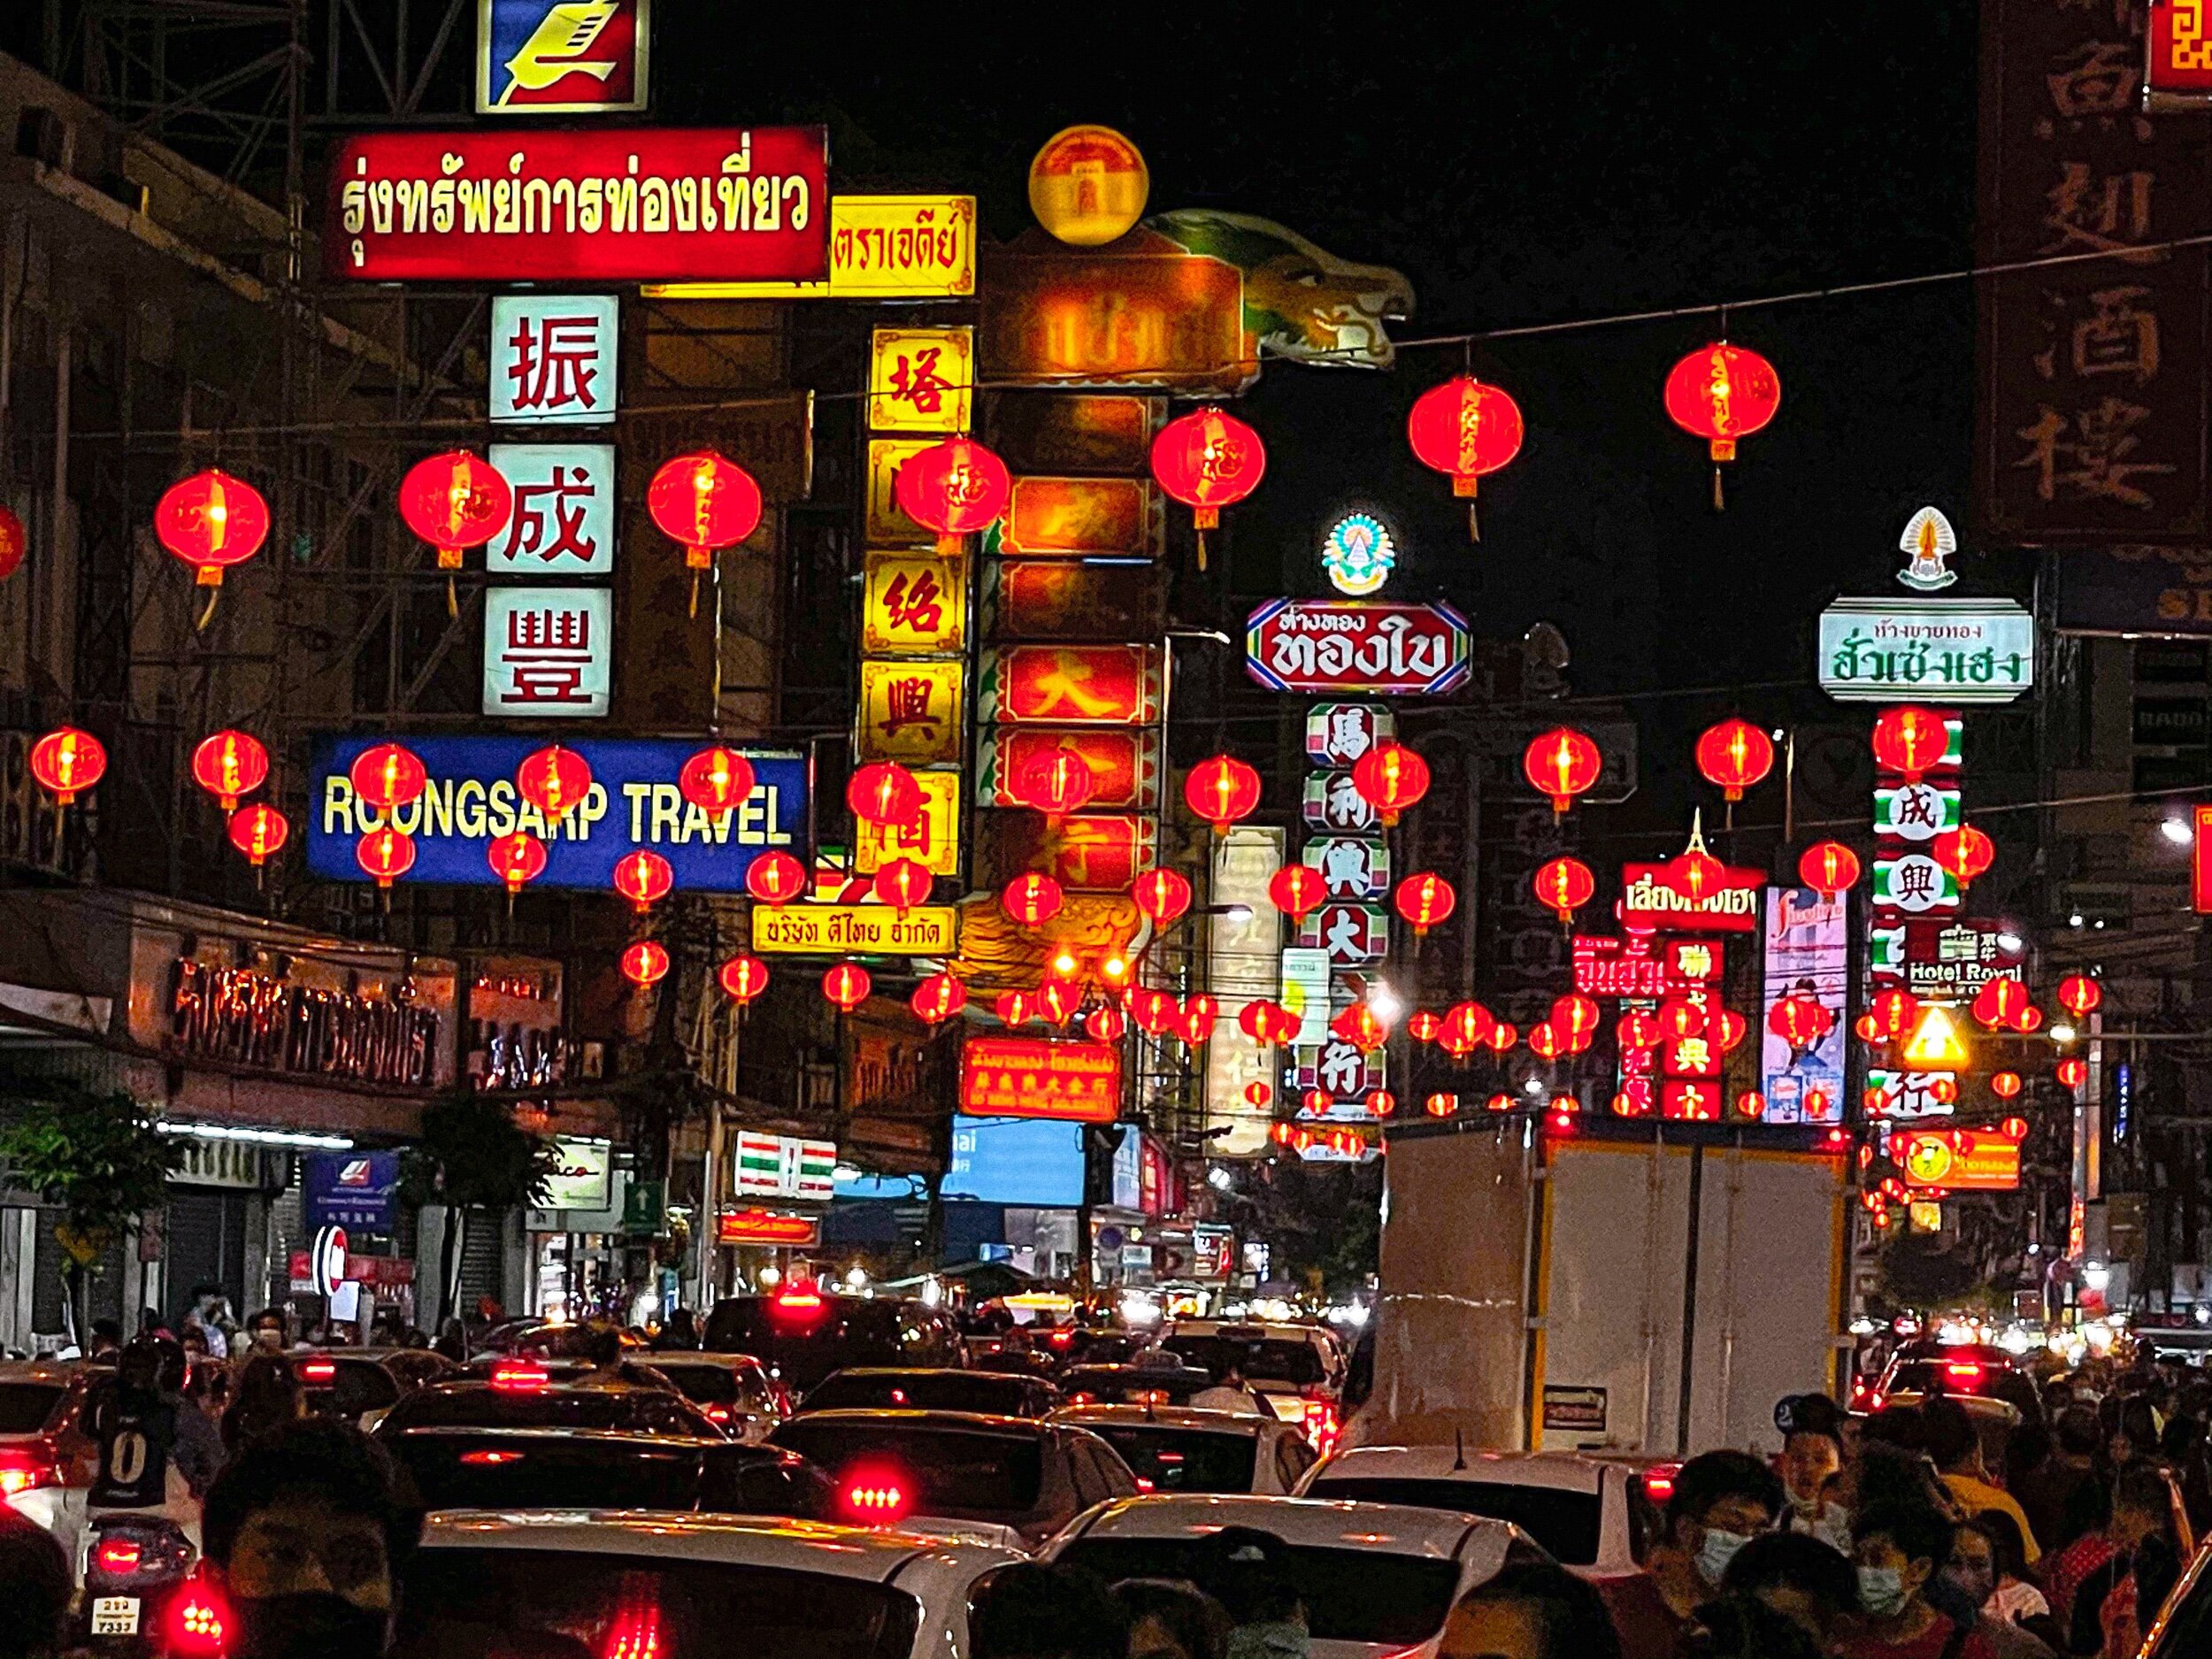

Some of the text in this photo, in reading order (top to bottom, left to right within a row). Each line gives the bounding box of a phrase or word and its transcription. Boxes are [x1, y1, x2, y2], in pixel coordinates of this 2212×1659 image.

[342, 132, 809, 268] รุ่งทรัพย์การท่องเที่ยว
[878, 347, 957, 858] 塔紹興
[1271, 614, 1446, 677] ทองใบ
[1909, 962, 1962, 981] Hotel
